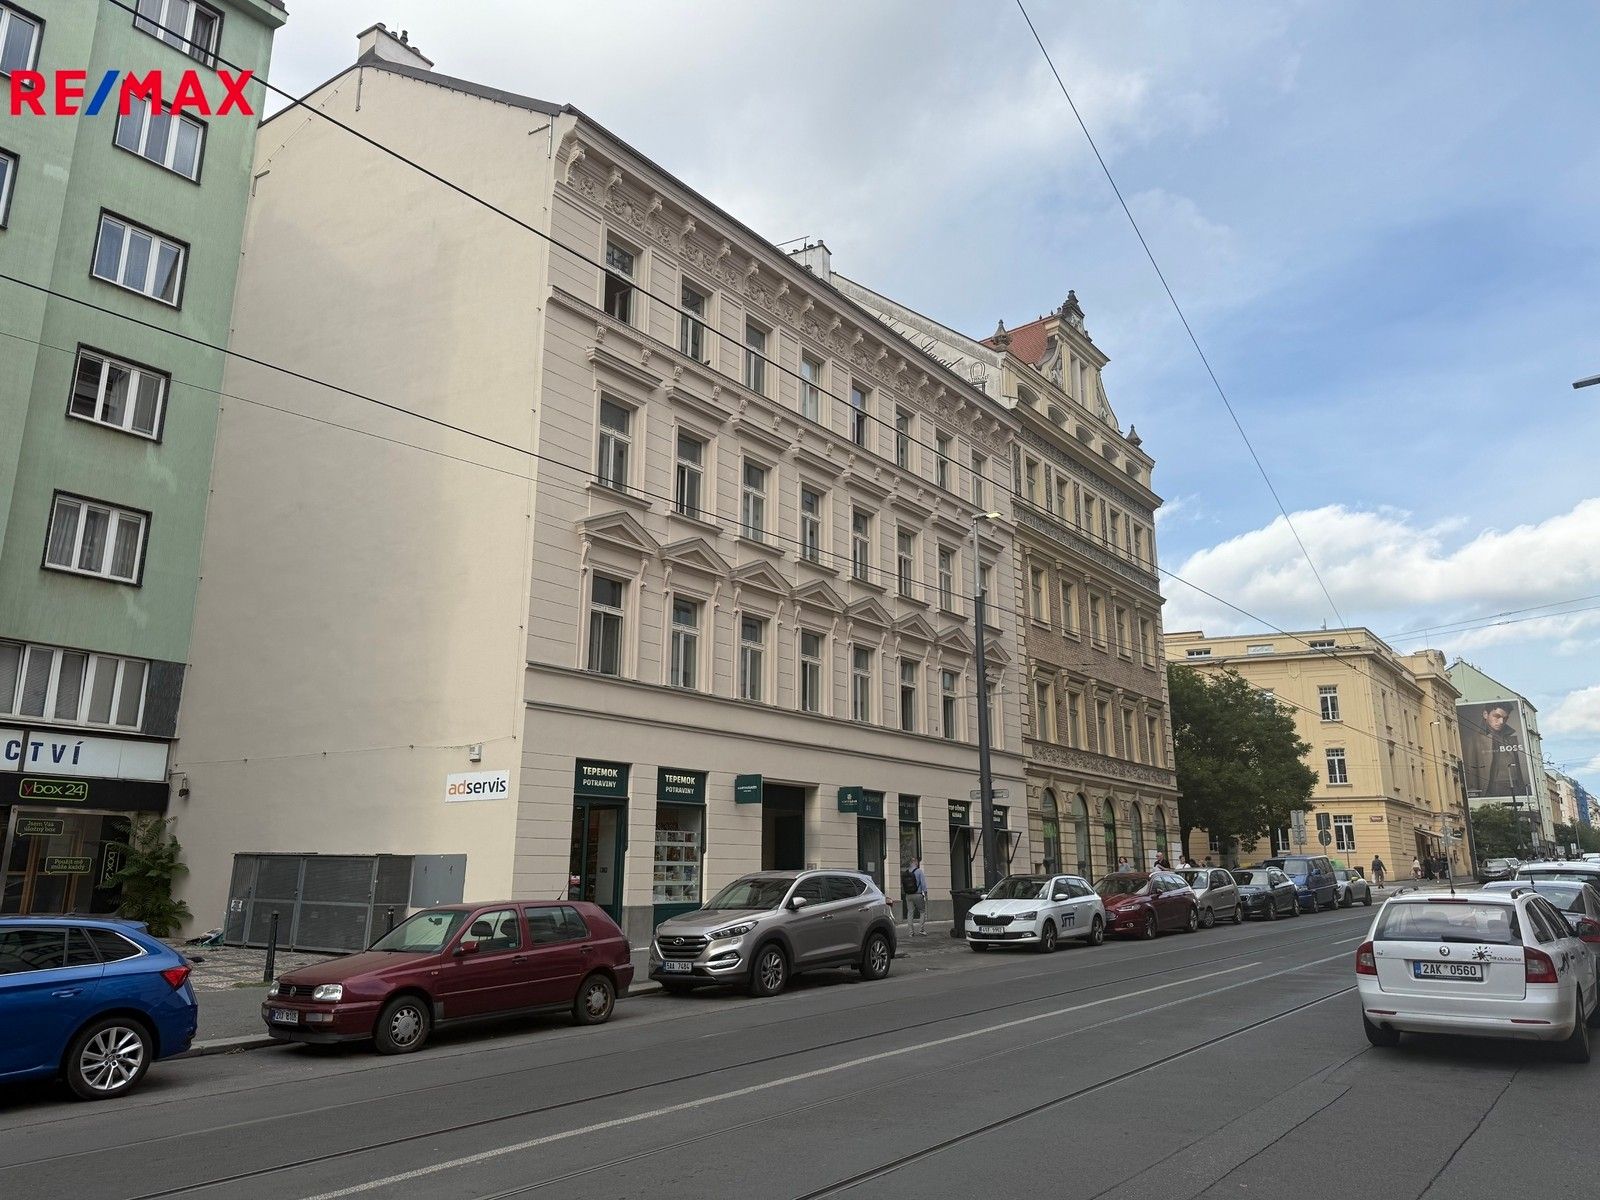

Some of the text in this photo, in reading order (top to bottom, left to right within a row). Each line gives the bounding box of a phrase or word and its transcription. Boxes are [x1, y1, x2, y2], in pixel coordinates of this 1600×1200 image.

[1499, 744, 1524, 752] BOSS
[64, 783, 85, 796] 24
[448, 777, 507, 796] adservis
[582, 778, 617, 789] POTRAVINY
[665, 785, 695, 795] POTRAVINY
[1422, 963, 1477, 976] 2AK 0560
